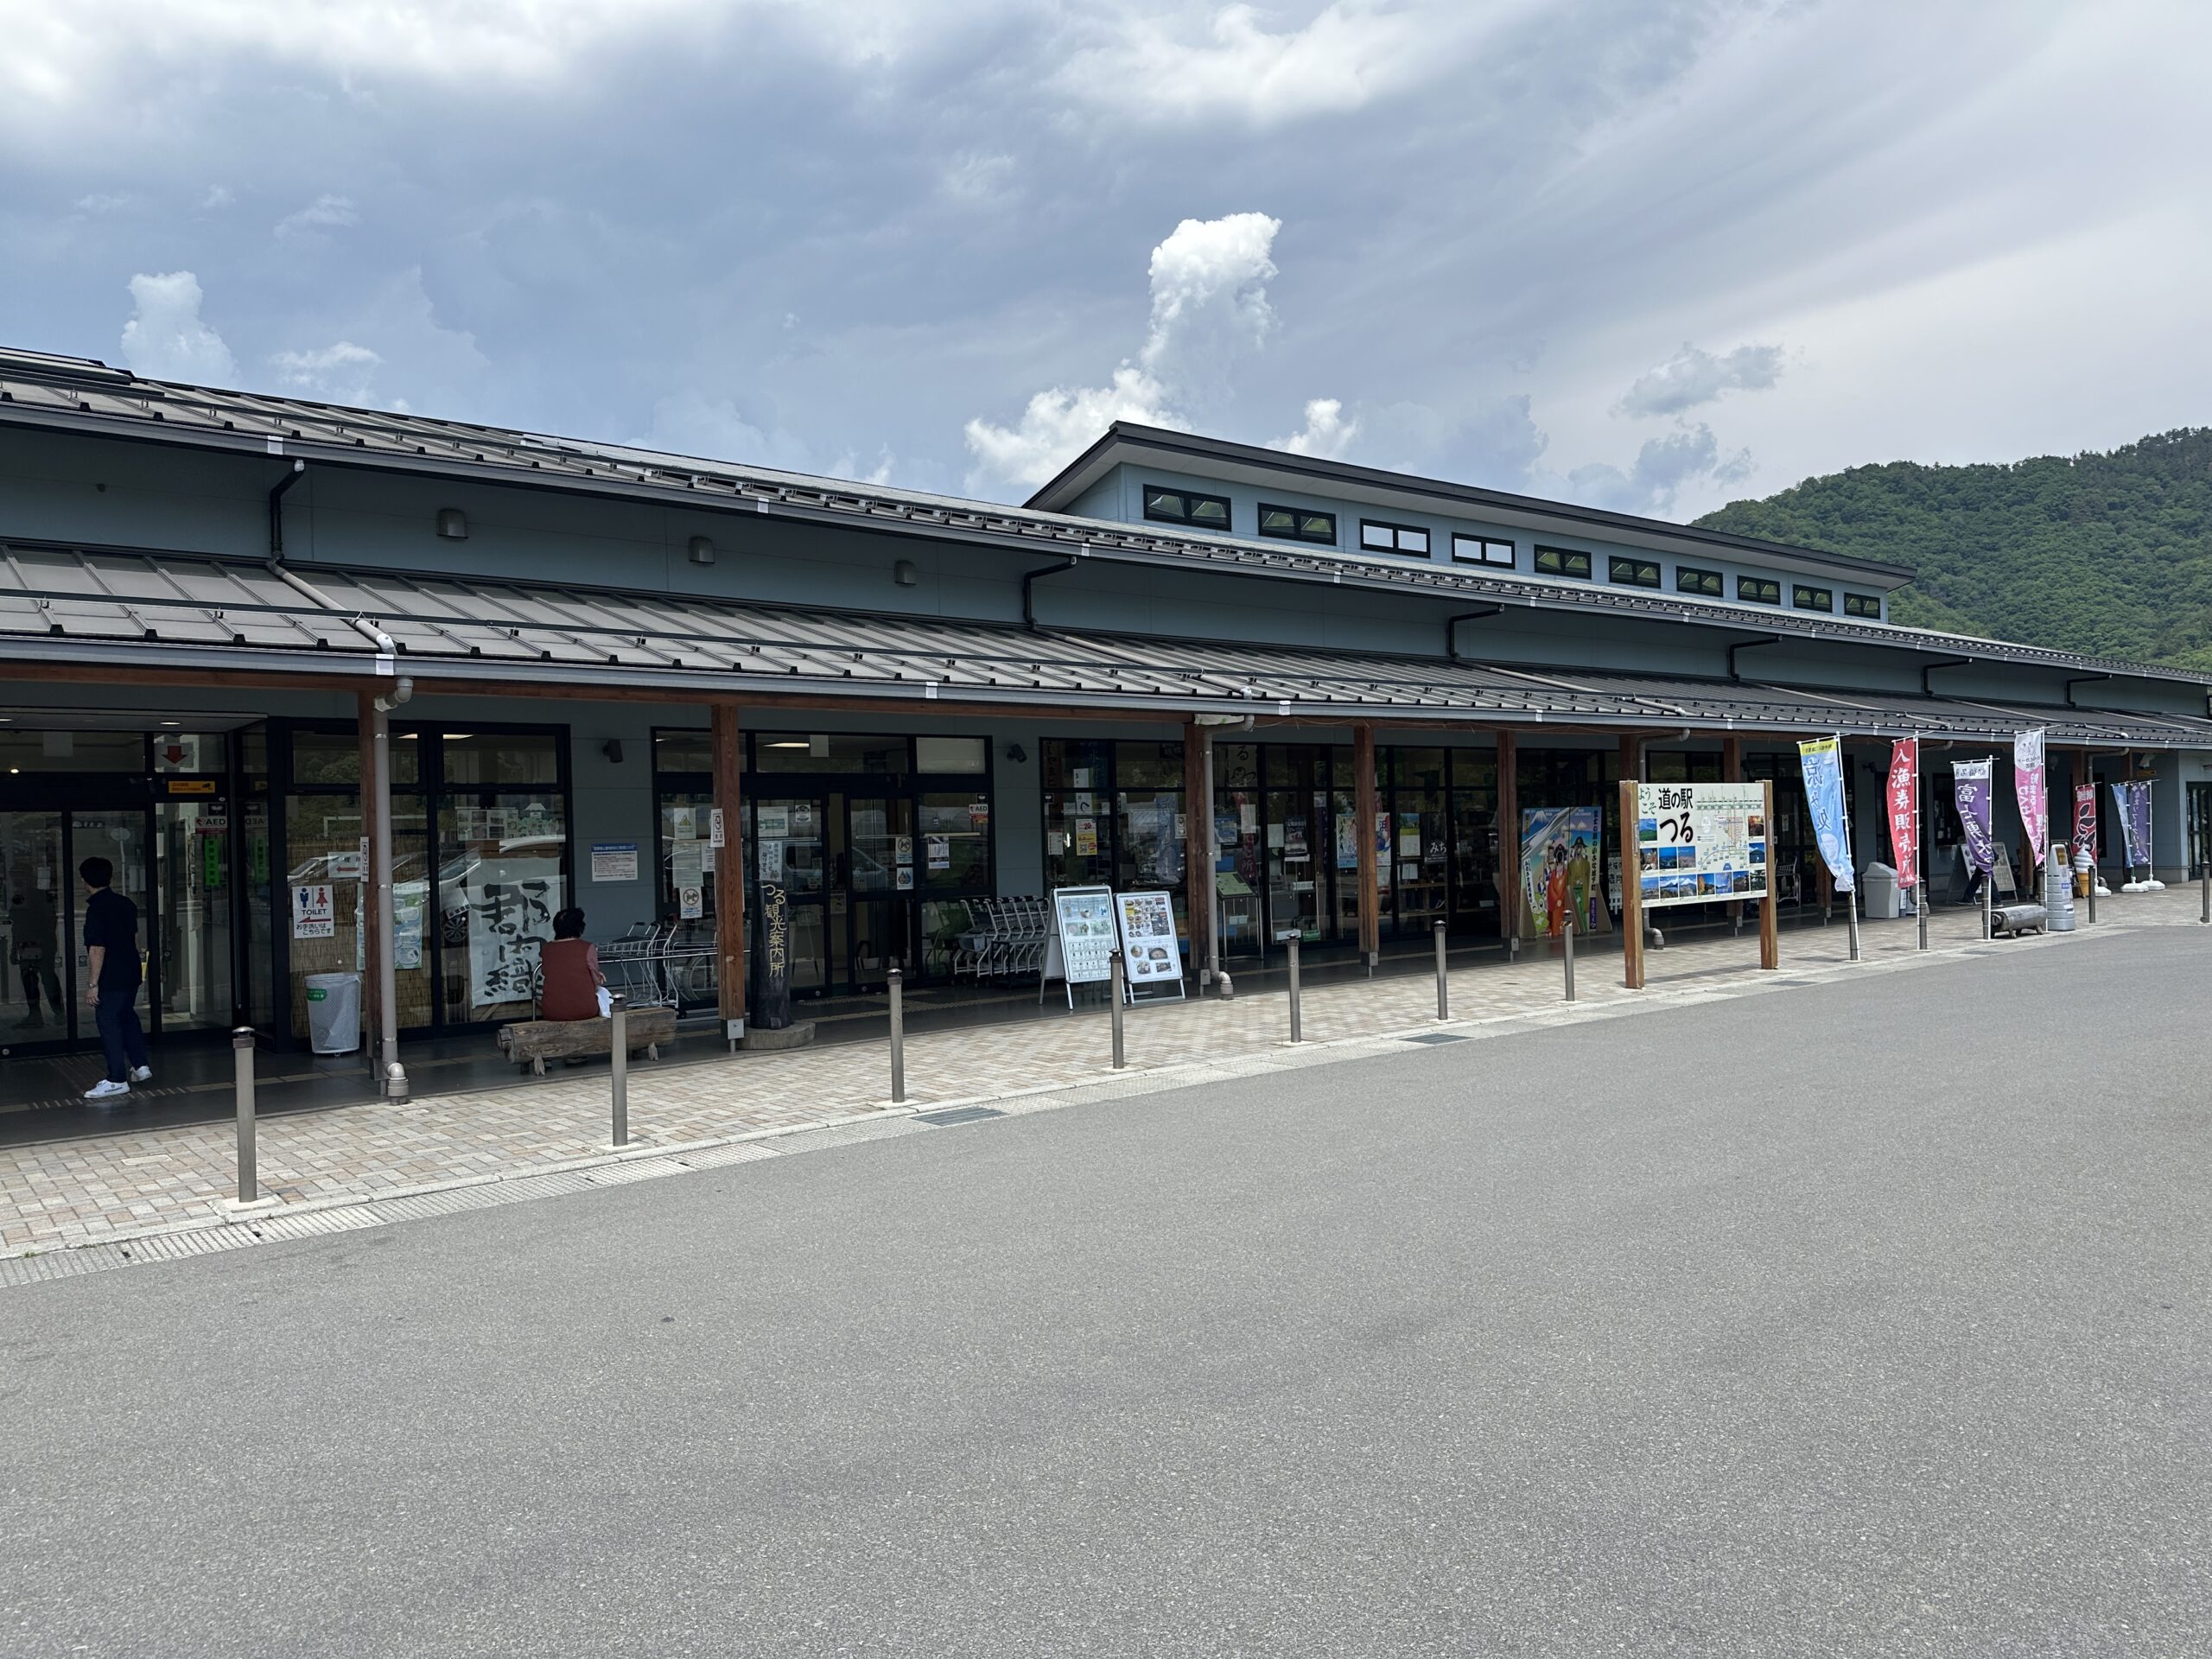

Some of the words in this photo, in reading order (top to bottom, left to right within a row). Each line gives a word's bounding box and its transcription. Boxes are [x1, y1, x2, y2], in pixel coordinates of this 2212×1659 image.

[1658, 787, 1694, 810] 道の駅
[1891, 747, 1911, 874] 入漁券販売所
[206, 817, 226, 826] AED
[1659, 810, 1694, 843] つる
[760, 883, 787, 978] つる観光案内所
